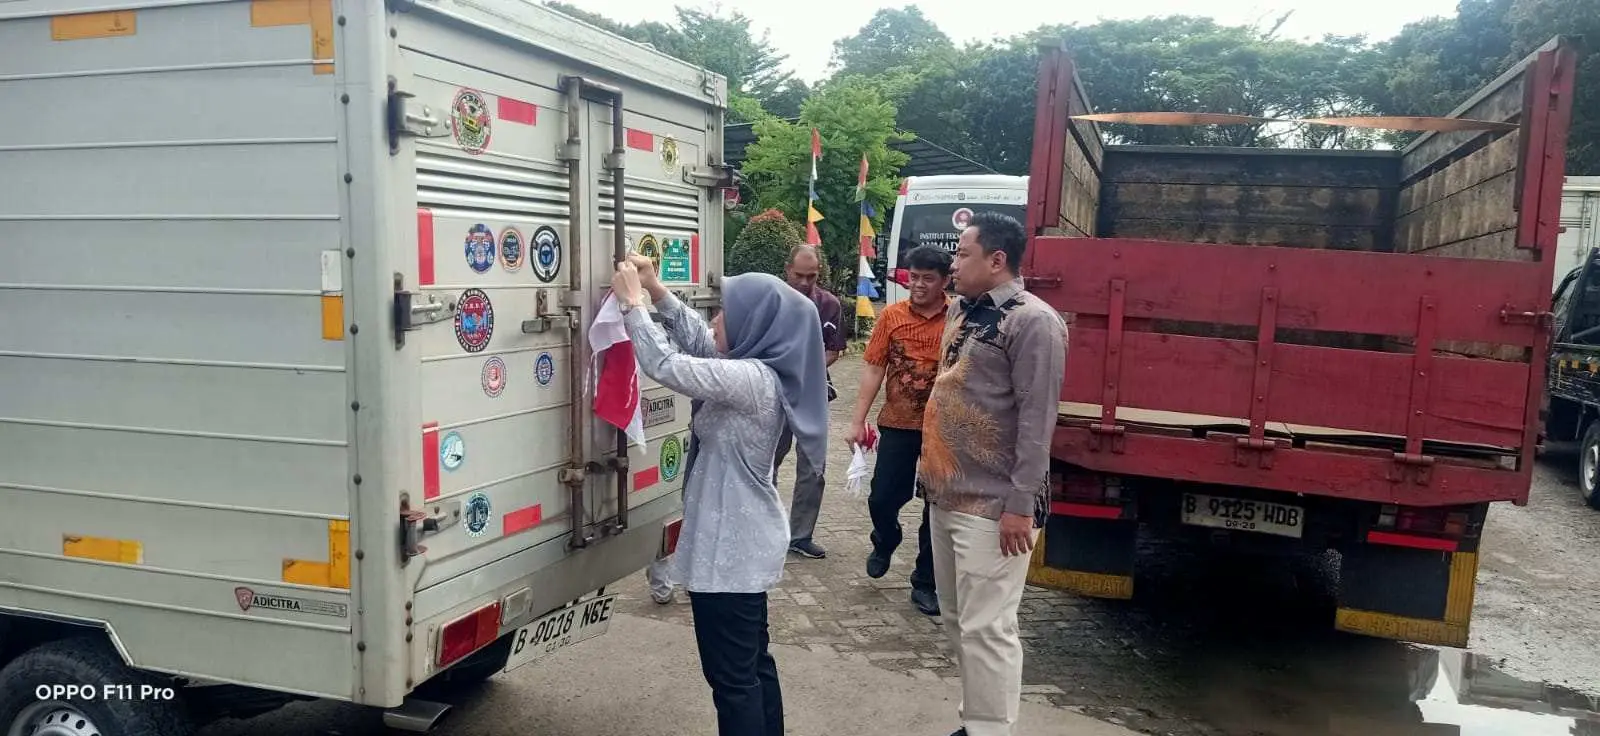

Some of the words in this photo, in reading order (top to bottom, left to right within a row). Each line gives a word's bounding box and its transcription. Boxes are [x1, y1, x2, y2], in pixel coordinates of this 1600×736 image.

[919, 232, 944, 240] INSTITUT
[648, 398, 674, 413] ADICITRA
[1185, 494, 1197, 514] B
[1209, 498, 1256, 520] 9125
[253, 596, 301, 610] ADICITRA
[514, 628, 528, 655] B
[531, 609, 576, 647] 9018
[580, 597, 613, 629] NGE
